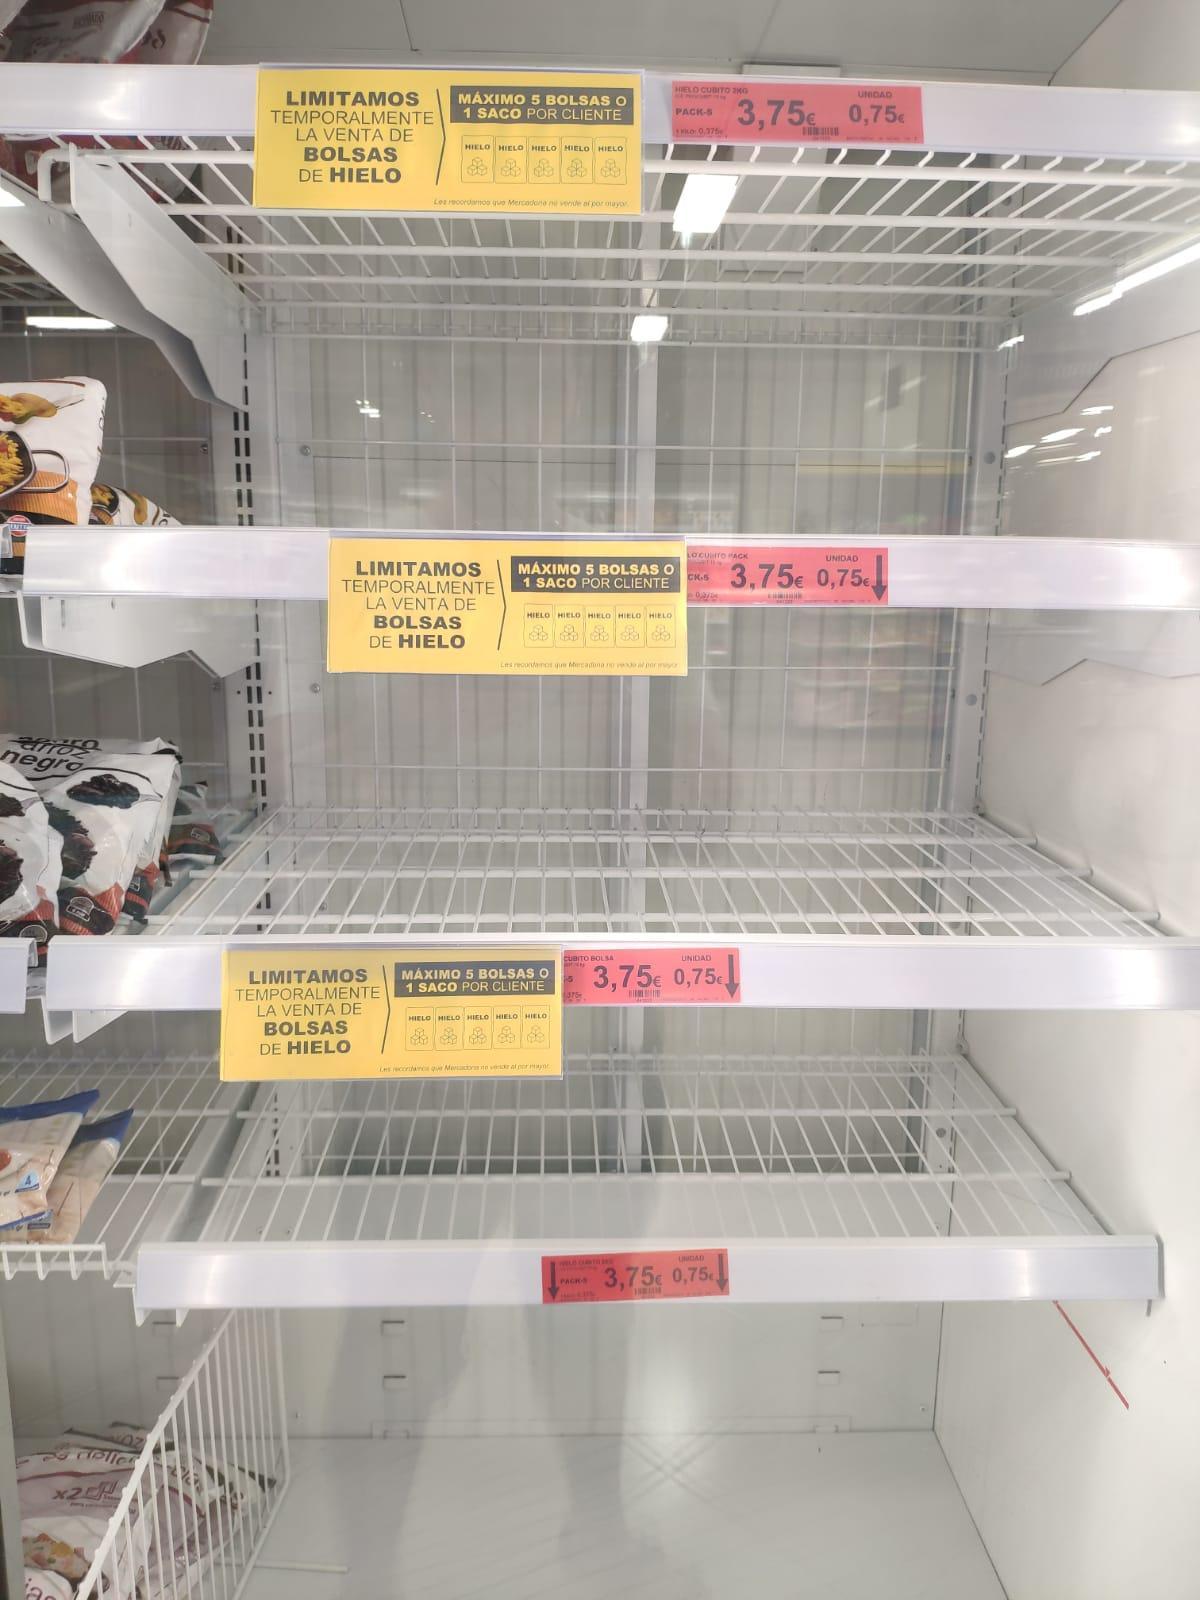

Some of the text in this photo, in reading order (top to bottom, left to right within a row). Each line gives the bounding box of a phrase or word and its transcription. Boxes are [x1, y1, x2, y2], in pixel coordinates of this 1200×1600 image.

[286, 91, 420, 107] LIMITAMOS
[458, 90, 627, 107] MÁXIMO 5 BOLSAS O
[858, 90, 893, 99] UNIDAD
[271, 110, 434, 126] TEMPORALMENTE
[463, 108, 622, 121] 1 SACO POR CLIENTE
[737, 99, 816, 131] 3,75€
[848, 104, 904, 126] 0,75€
[296, 128, 413, 143] LA VENTA DE
[304, 147, 398, 163] BOLSAS
[299, 167, 402, 184] DE HIELO
[355, 561, 481, 578] LIMITAMOS
[518, 562, 674, 576] MÁXIMO 5 BOLSAS O
[730, 563, 804, 590] 3,75€
[523, 577, 670, 589] 1 SACO POR CLIENTE
[817, 568, 870, 589] 0,75€
[342, 580, 495, 595] TEMPORALMENTE
[366, 597, 476, 611] LA VENTA DE
[374, 615, 462, 630] BOLSAS
[369, 634, 465, 649] DE HIELO
[0, 749, 84, 772] negro
[248, 968, 368, 985] LIMITAMOS
[402, 966, 549, 980] MÁXIMO 5 BOLSAS O
[593, 965, 662, 992] 3,75€
[674, 968, 723, 988] 0,75€
[236, 986, 380, 1001] TEMPORALMENTE
[406, 980, 545, 993] 1 SACO POR CLIENTE
[257, 1002, 362, 1018] LA VENTA DE
[264, 1021, 348, 1036] BOLSAS
[260, 1040, 351, 1056] DE HIELO
[678, 1255, 705, 1263] UNIDAD
[604, 1266, 662, 1292] 3,75€
[672, 1267, 714, 1285] 0,75€
[52, 1487, 82, 1500] x2
